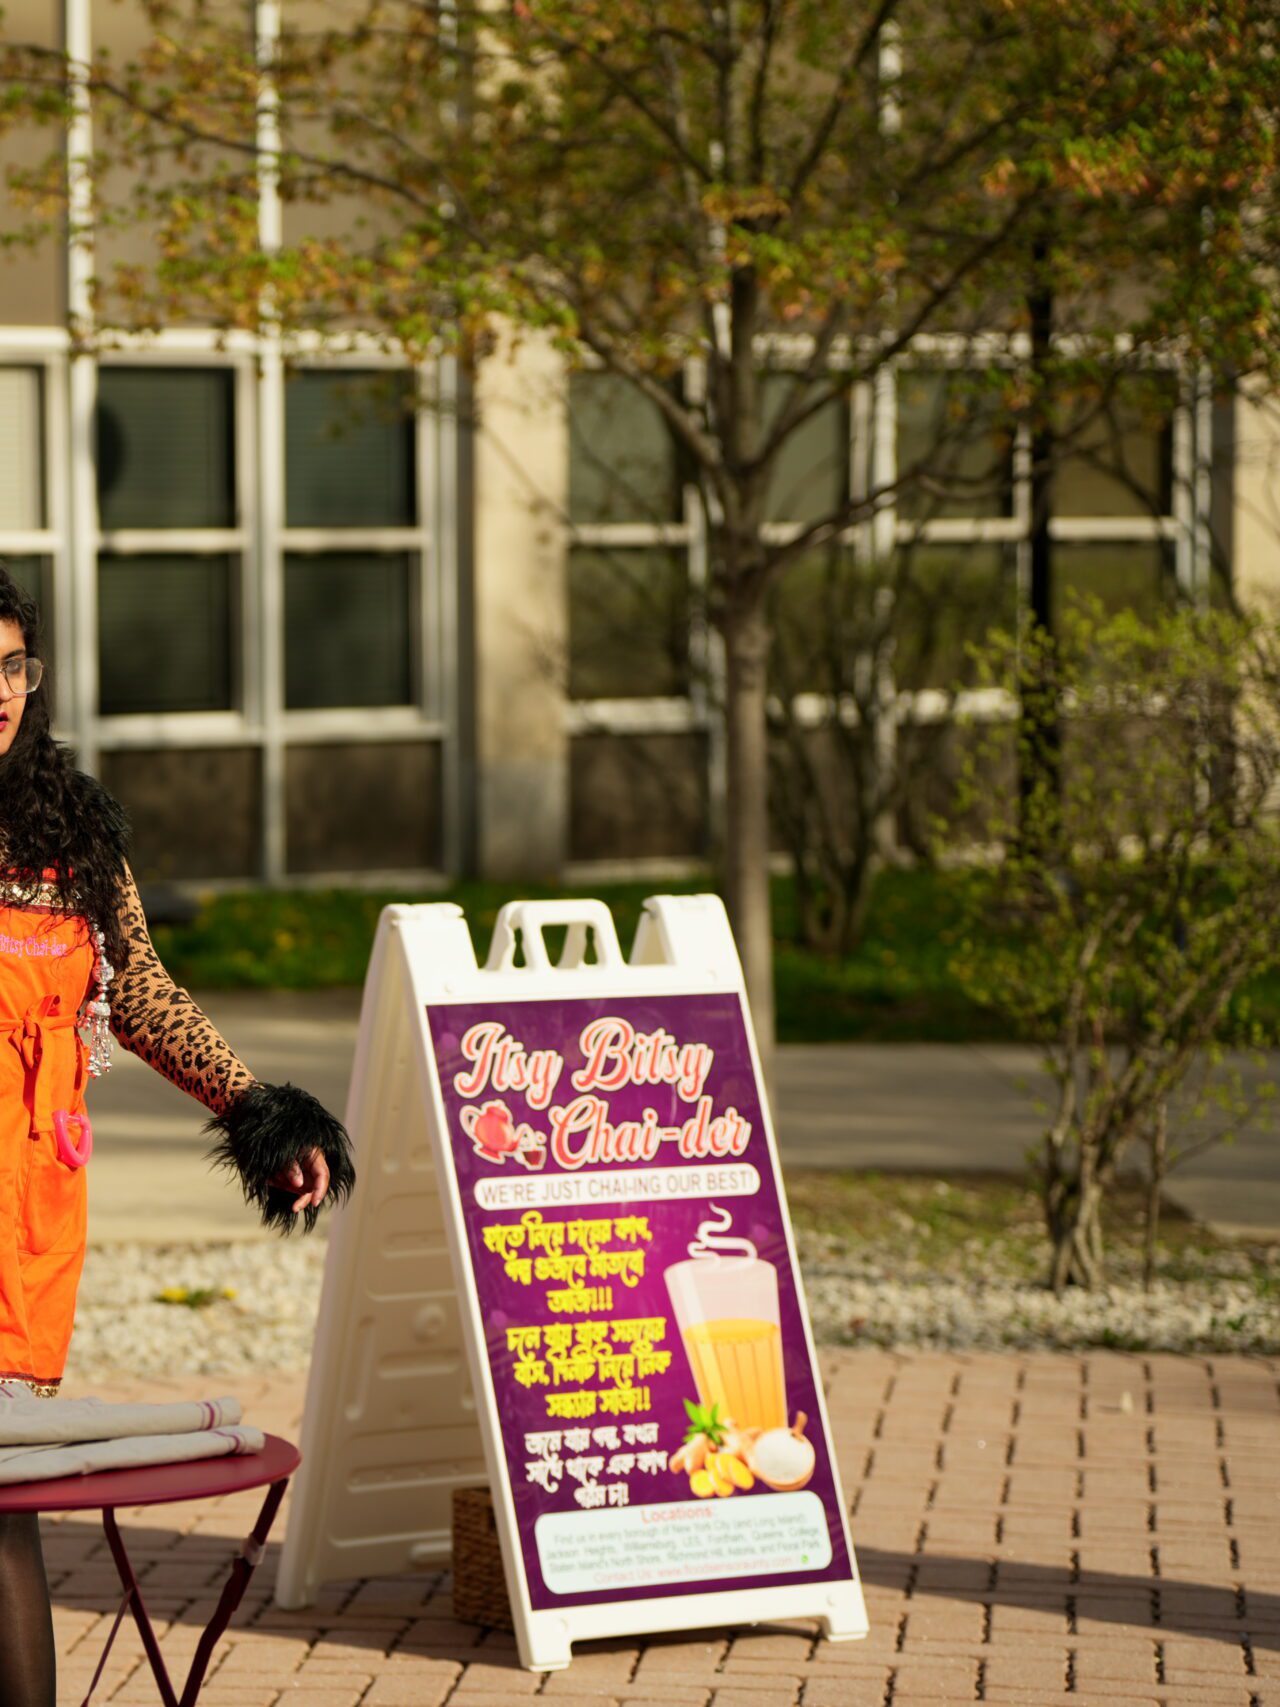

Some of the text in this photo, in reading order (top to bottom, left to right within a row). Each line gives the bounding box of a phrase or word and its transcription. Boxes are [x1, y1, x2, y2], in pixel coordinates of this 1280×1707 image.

[454, 1016, 713, 1110] Itsy Bitsy
[549, 1094, 752, 1170] Chai-der
[481, 1170, 754, 1204] WE'RE JUST CHAI-ING OUR BEST!
